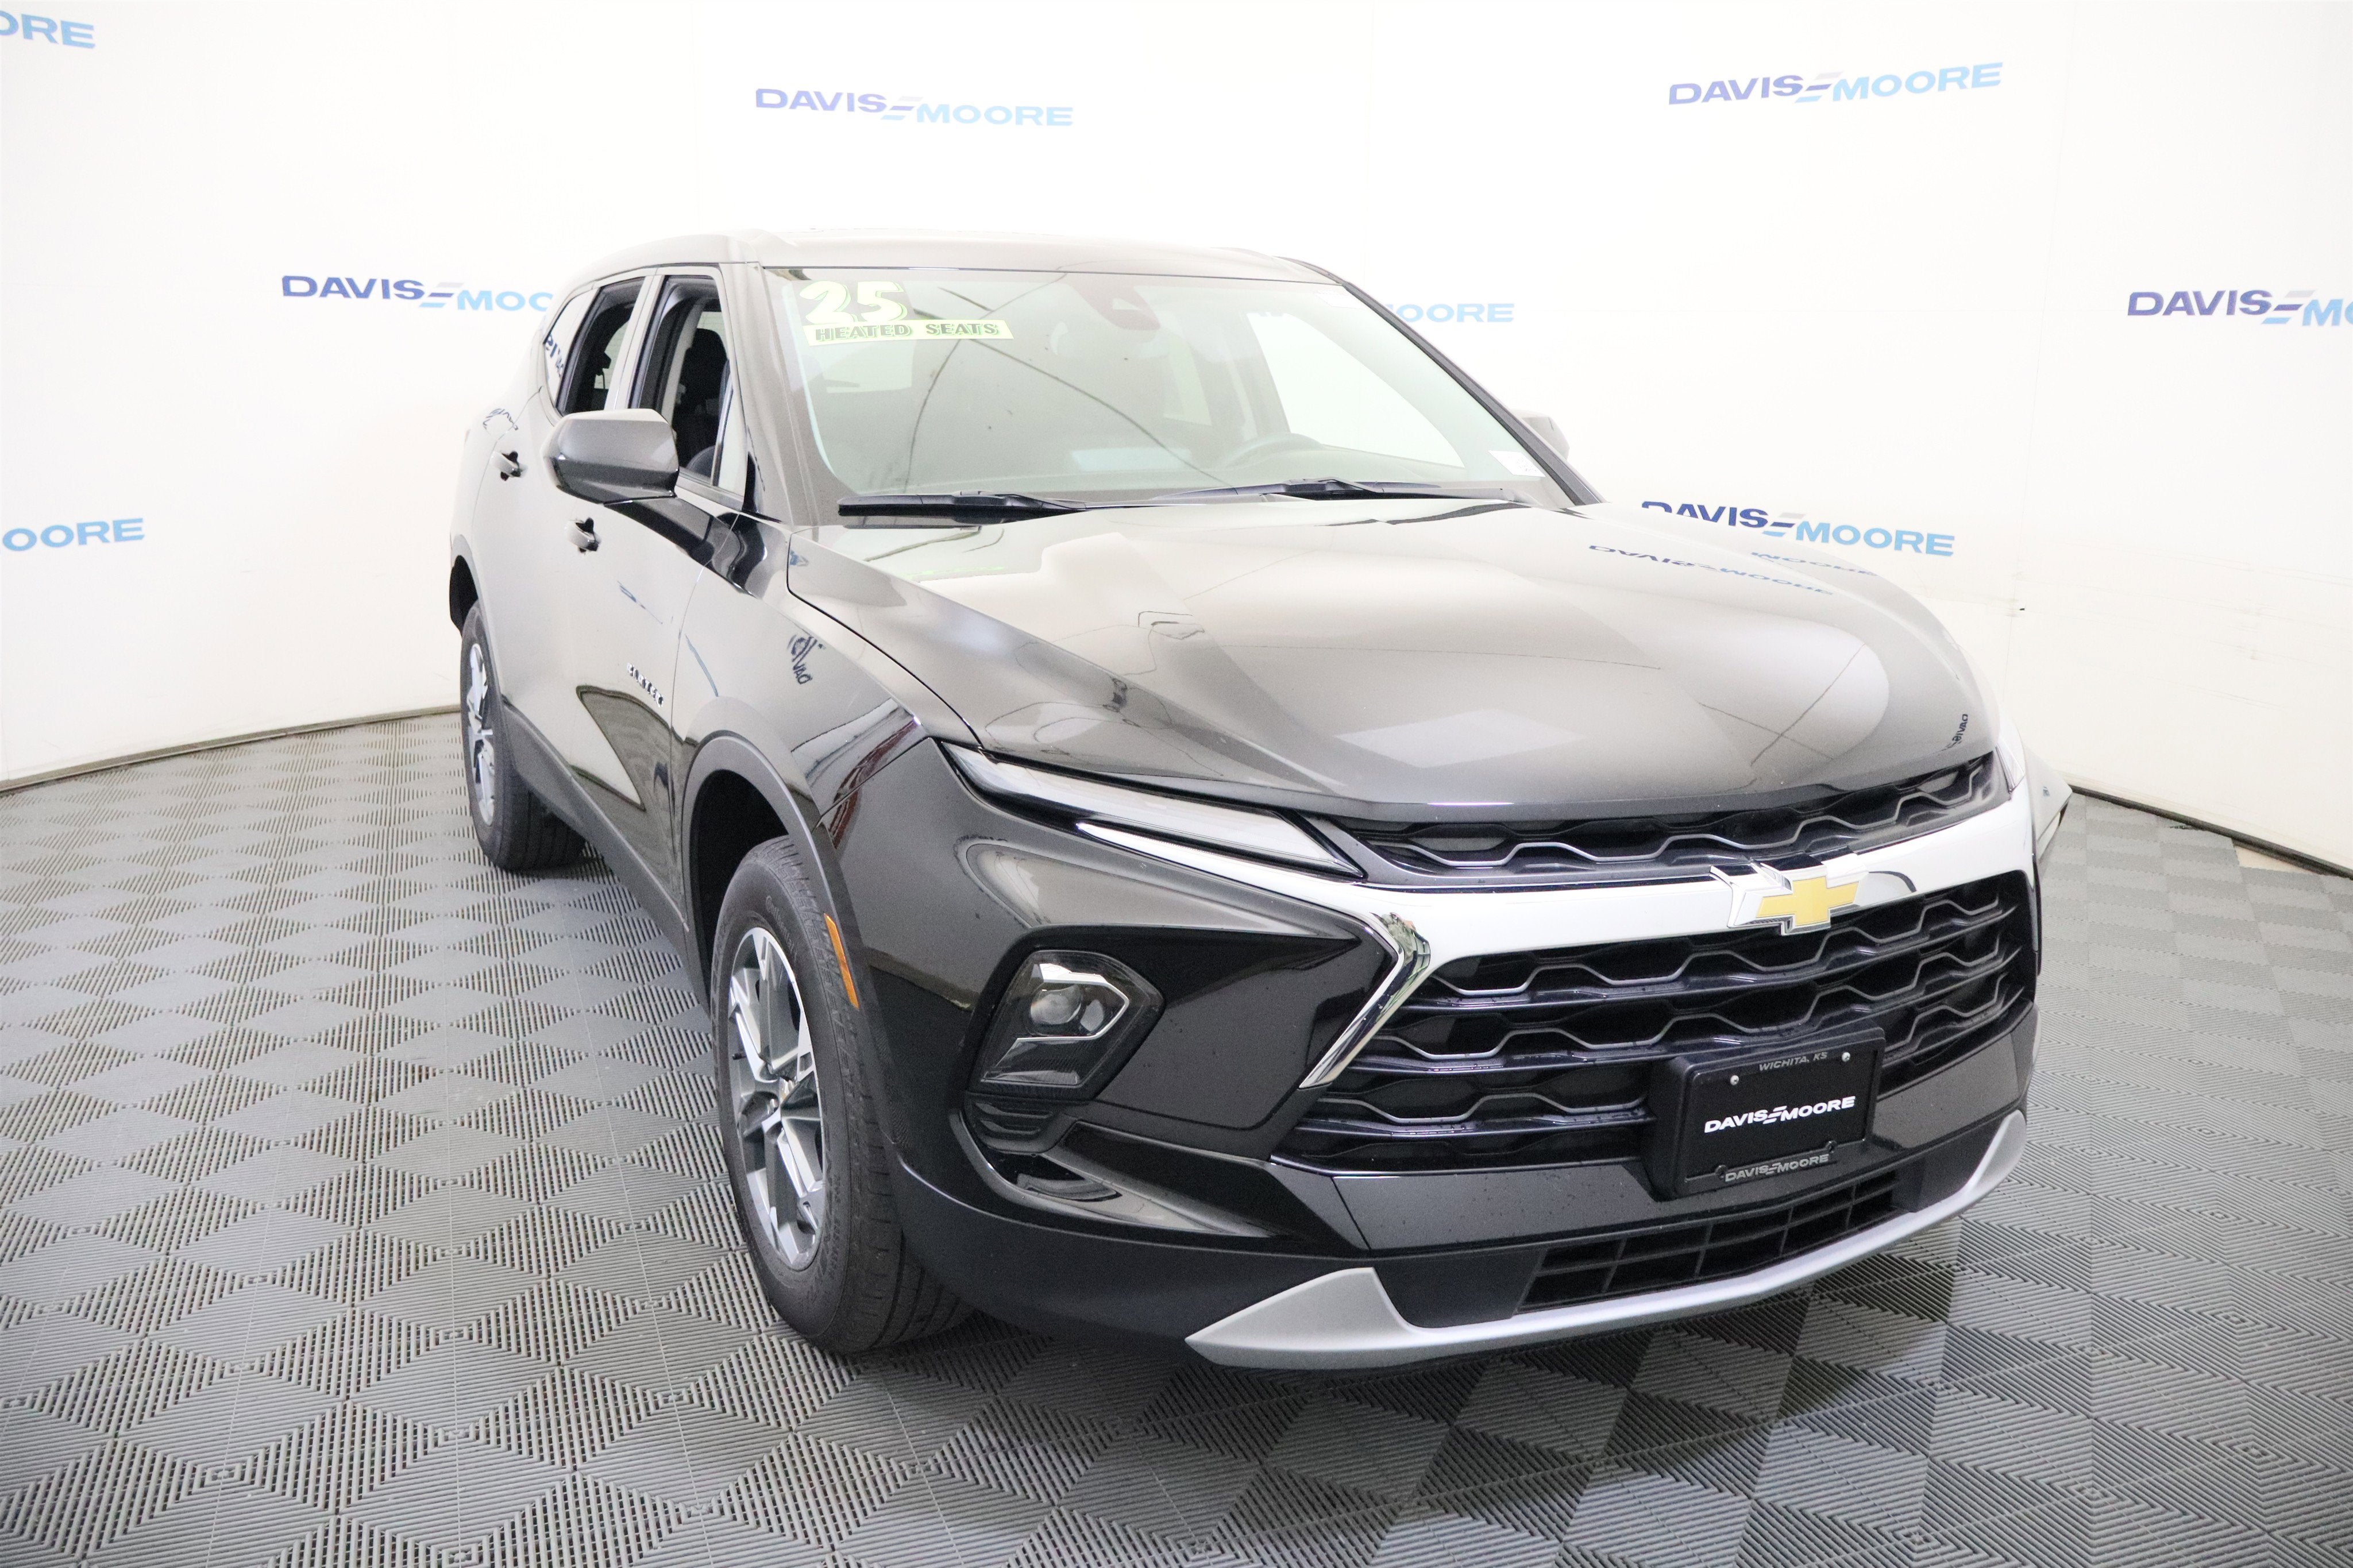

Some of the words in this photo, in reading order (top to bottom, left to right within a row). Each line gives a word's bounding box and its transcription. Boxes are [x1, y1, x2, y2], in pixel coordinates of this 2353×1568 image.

[0, 9, 96, 49] ORE
[1669, 75, 1803, 105] DAVIS
[1833, 62, 2003, 102] MOORE
[756, 88, 887, 113] DAVIS
[917, 104, 1074, 126] MOORE
[282, 275, 426, 300] DAVIS
[457, 289, 553, 312] MOO
[800, 281, 908, 324] 25
[2128, 289, 2272, 315] DAVIS
[1386, 303, 1515, 323] OORE
[815, 324, 911, 342] HEATED
[925, 323, 1000, 335] SEATS
[1, 517, 146, 551] OORE
[1795, 520, 1955, 557] MOORE
[1759, 1056, 1809, 1071] WICHITA,
[1814, 1052, 1827, 1061] KS
[1704, 1110, 1769, 1133] DAVIS
[1780, 1096, 1856, 1122] MOORE
[1725, 1164, 1769, 1182] DAVIS
[1777, 1154, 1829, 1173] MOORE
